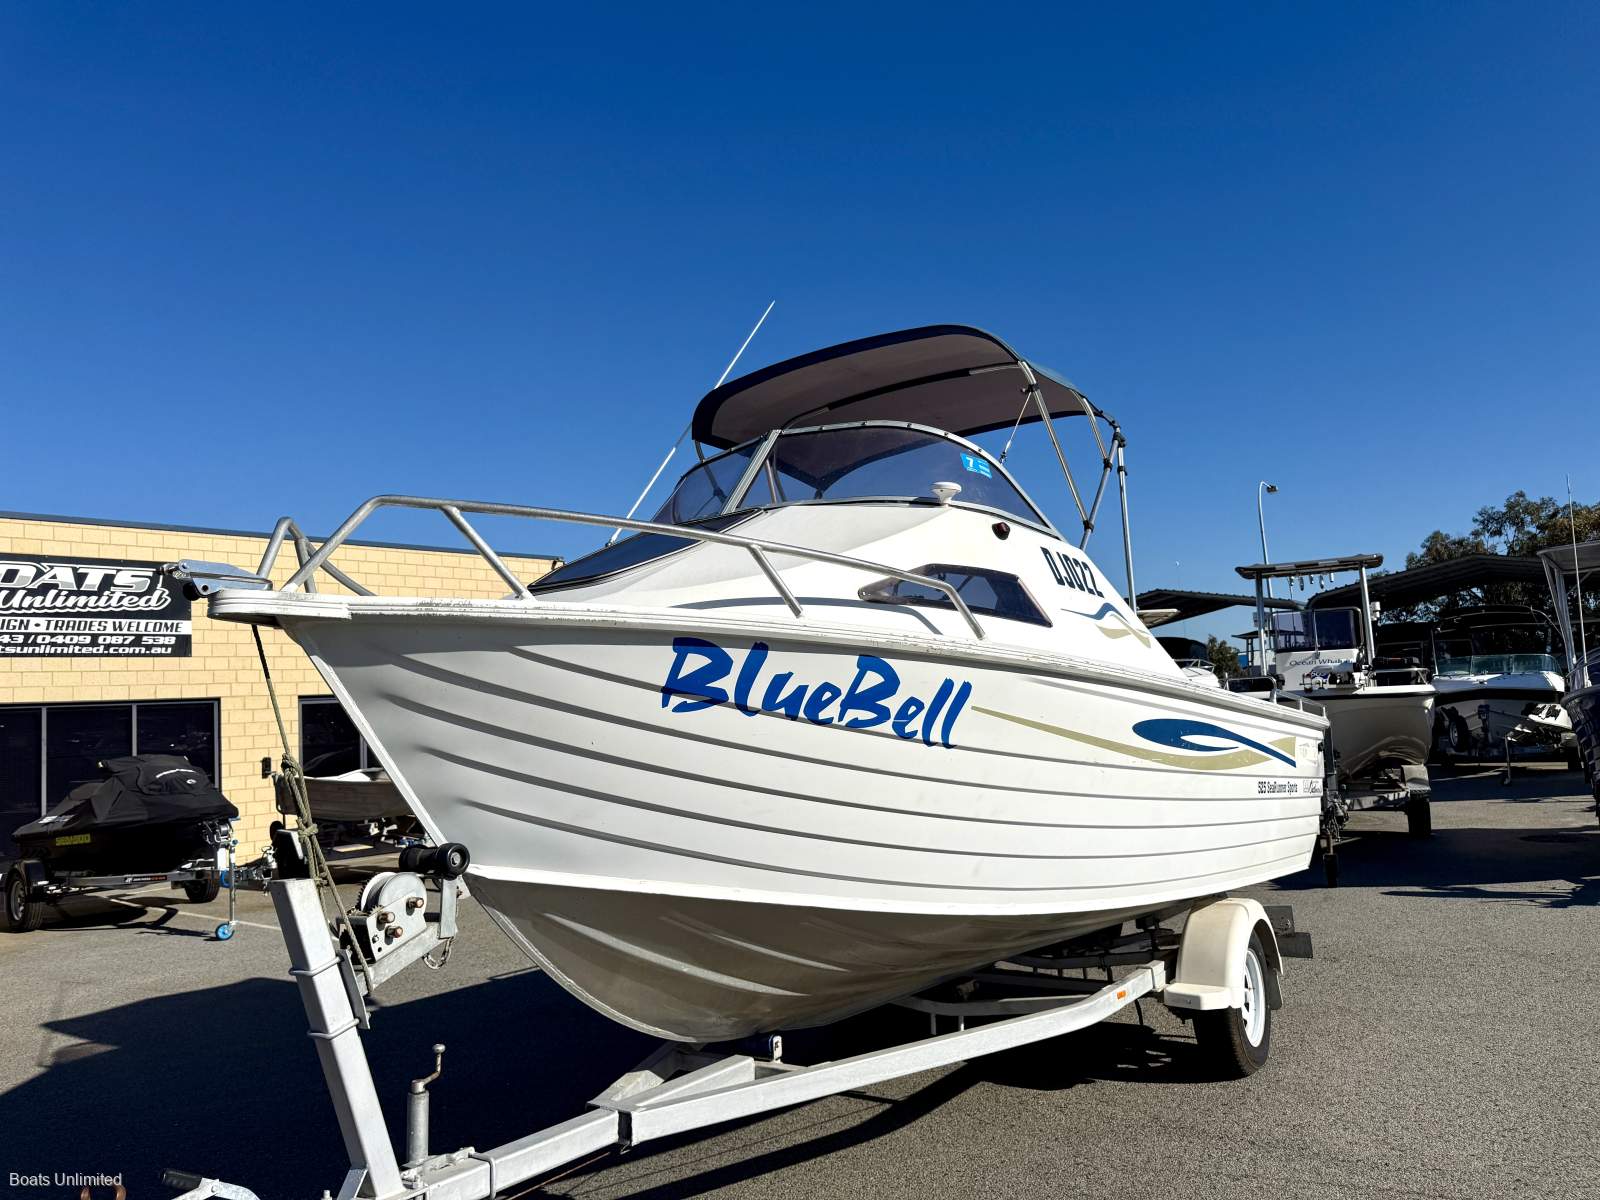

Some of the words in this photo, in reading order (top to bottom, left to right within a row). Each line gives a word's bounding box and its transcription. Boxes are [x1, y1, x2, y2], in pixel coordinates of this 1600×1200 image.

[966, 456, 974, 467] 7
[1040, 546, 1105, 599] DJ022
[0, 588, 164, 610] Unlimited
[45, 620, 108, 632] TRADES
[112, 620, 183, 633] WELCOME
[98, 635, 134, 645] 087
[141, 636, 176, 645] 538
[1290, 659, 1317, 667] Ocean
[661, 636, 973, 749] BlueBell
